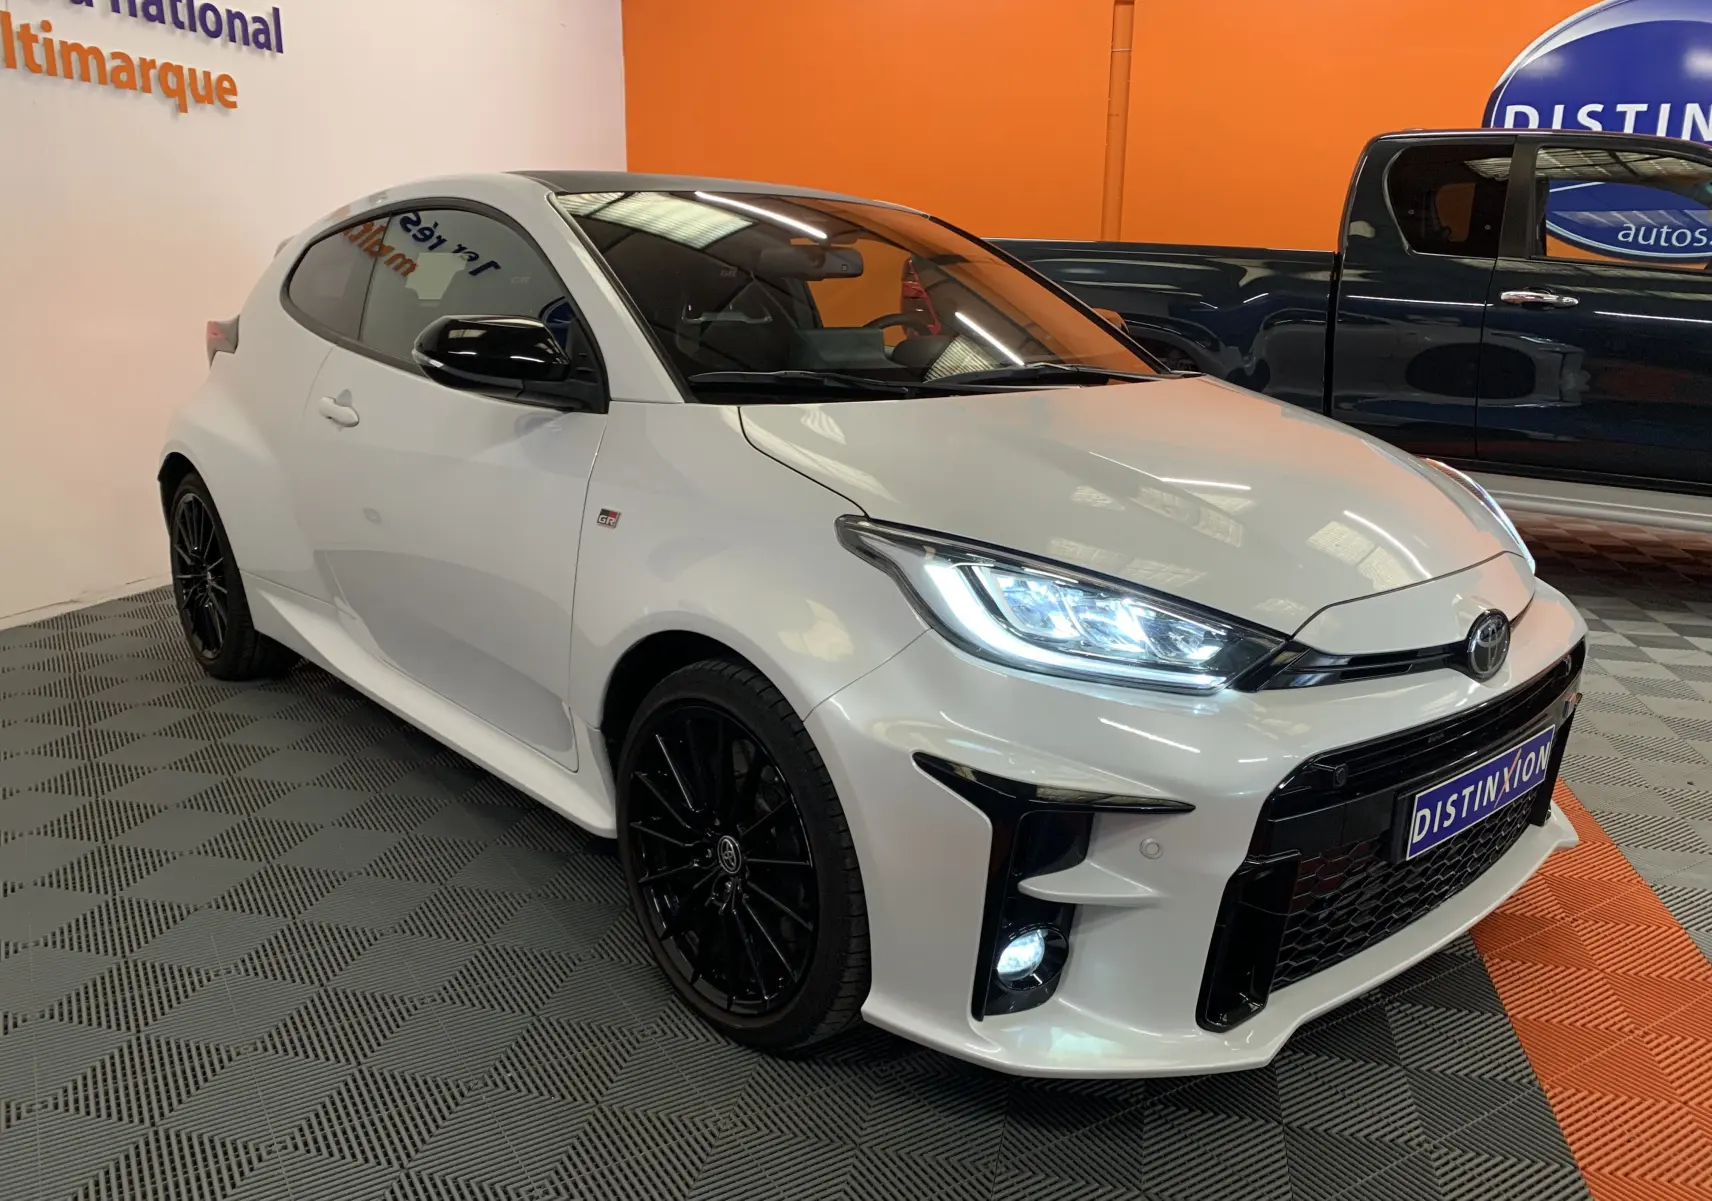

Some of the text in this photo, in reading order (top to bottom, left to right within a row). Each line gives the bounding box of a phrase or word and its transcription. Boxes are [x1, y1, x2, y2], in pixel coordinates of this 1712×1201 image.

[0, 10, 238, 113] ltimarque
[598, 514, 615, 527] GR
[1412, 741, 1551, 843] DISTINXION
